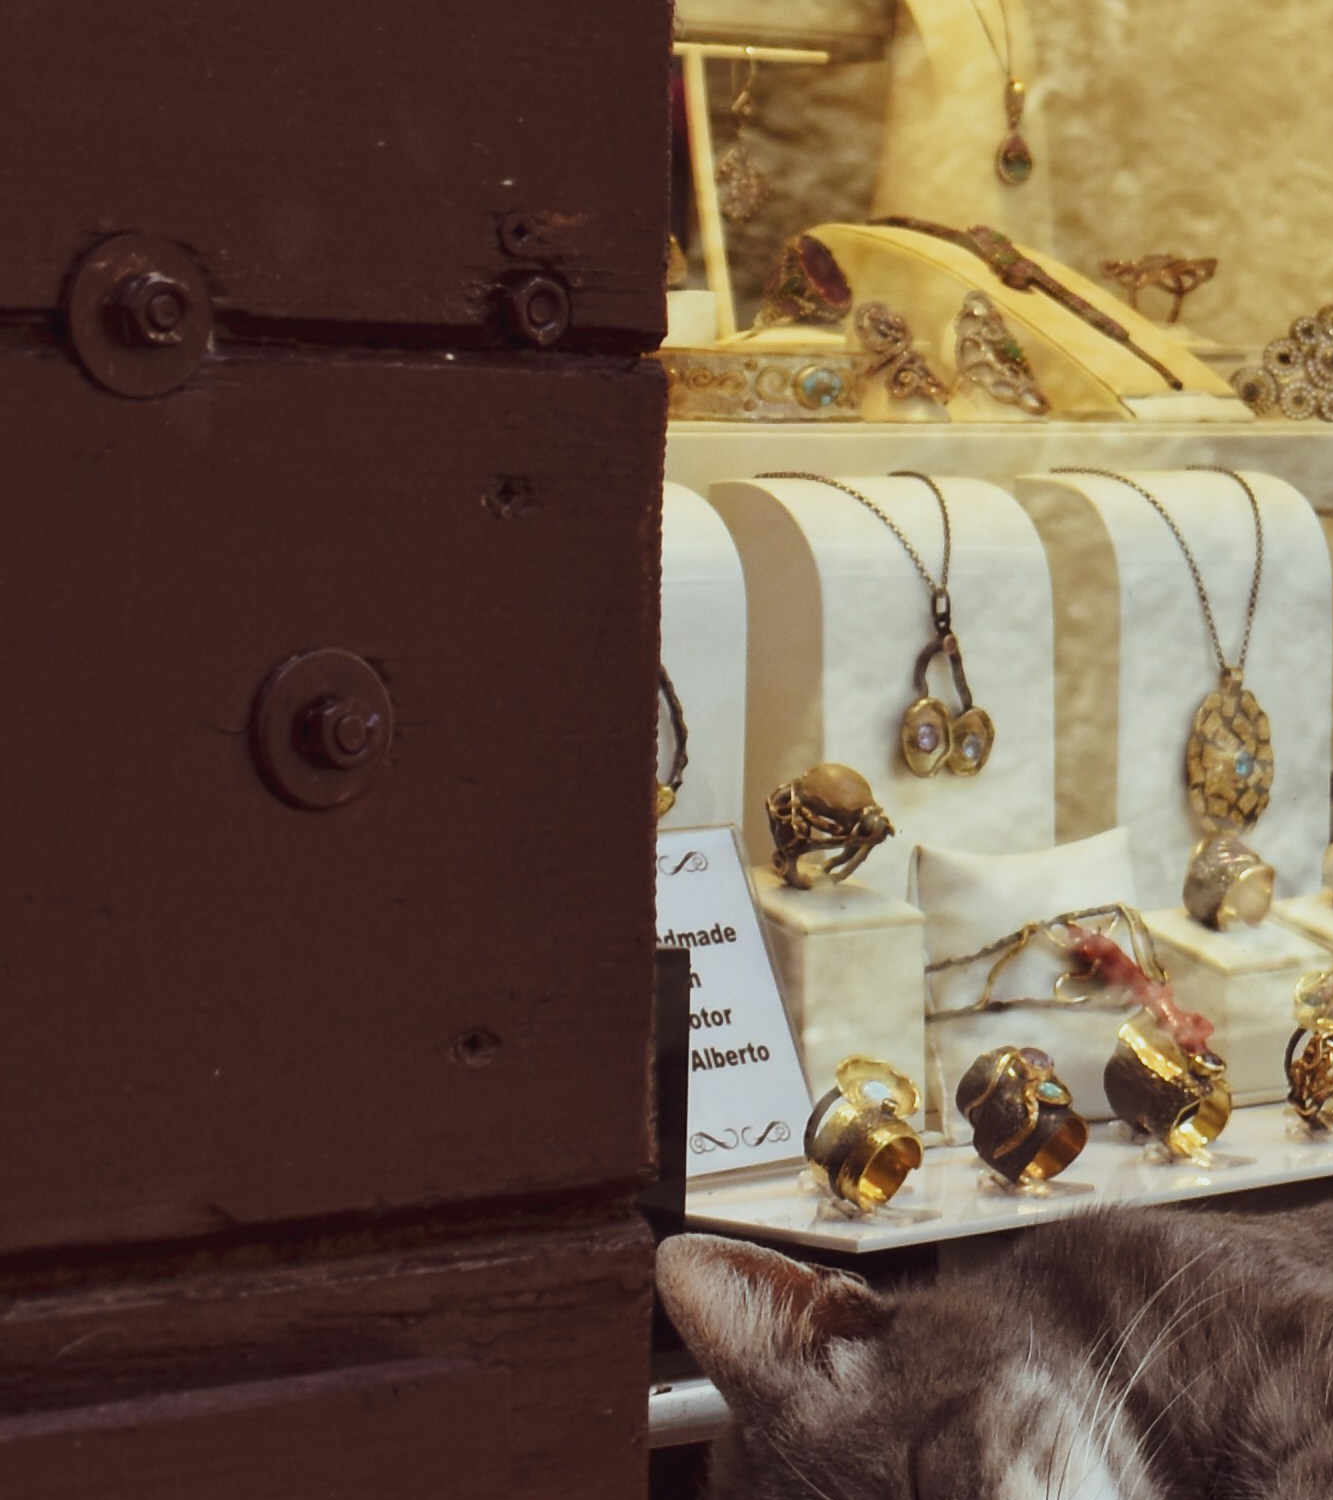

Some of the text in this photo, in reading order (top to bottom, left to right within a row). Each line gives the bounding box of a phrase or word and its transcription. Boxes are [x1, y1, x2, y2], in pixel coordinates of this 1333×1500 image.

[656, 922, 737, 948] dmade
[689, 1006, 732, 1030] otor
[692, 1042, 770, 1072] Alberto
